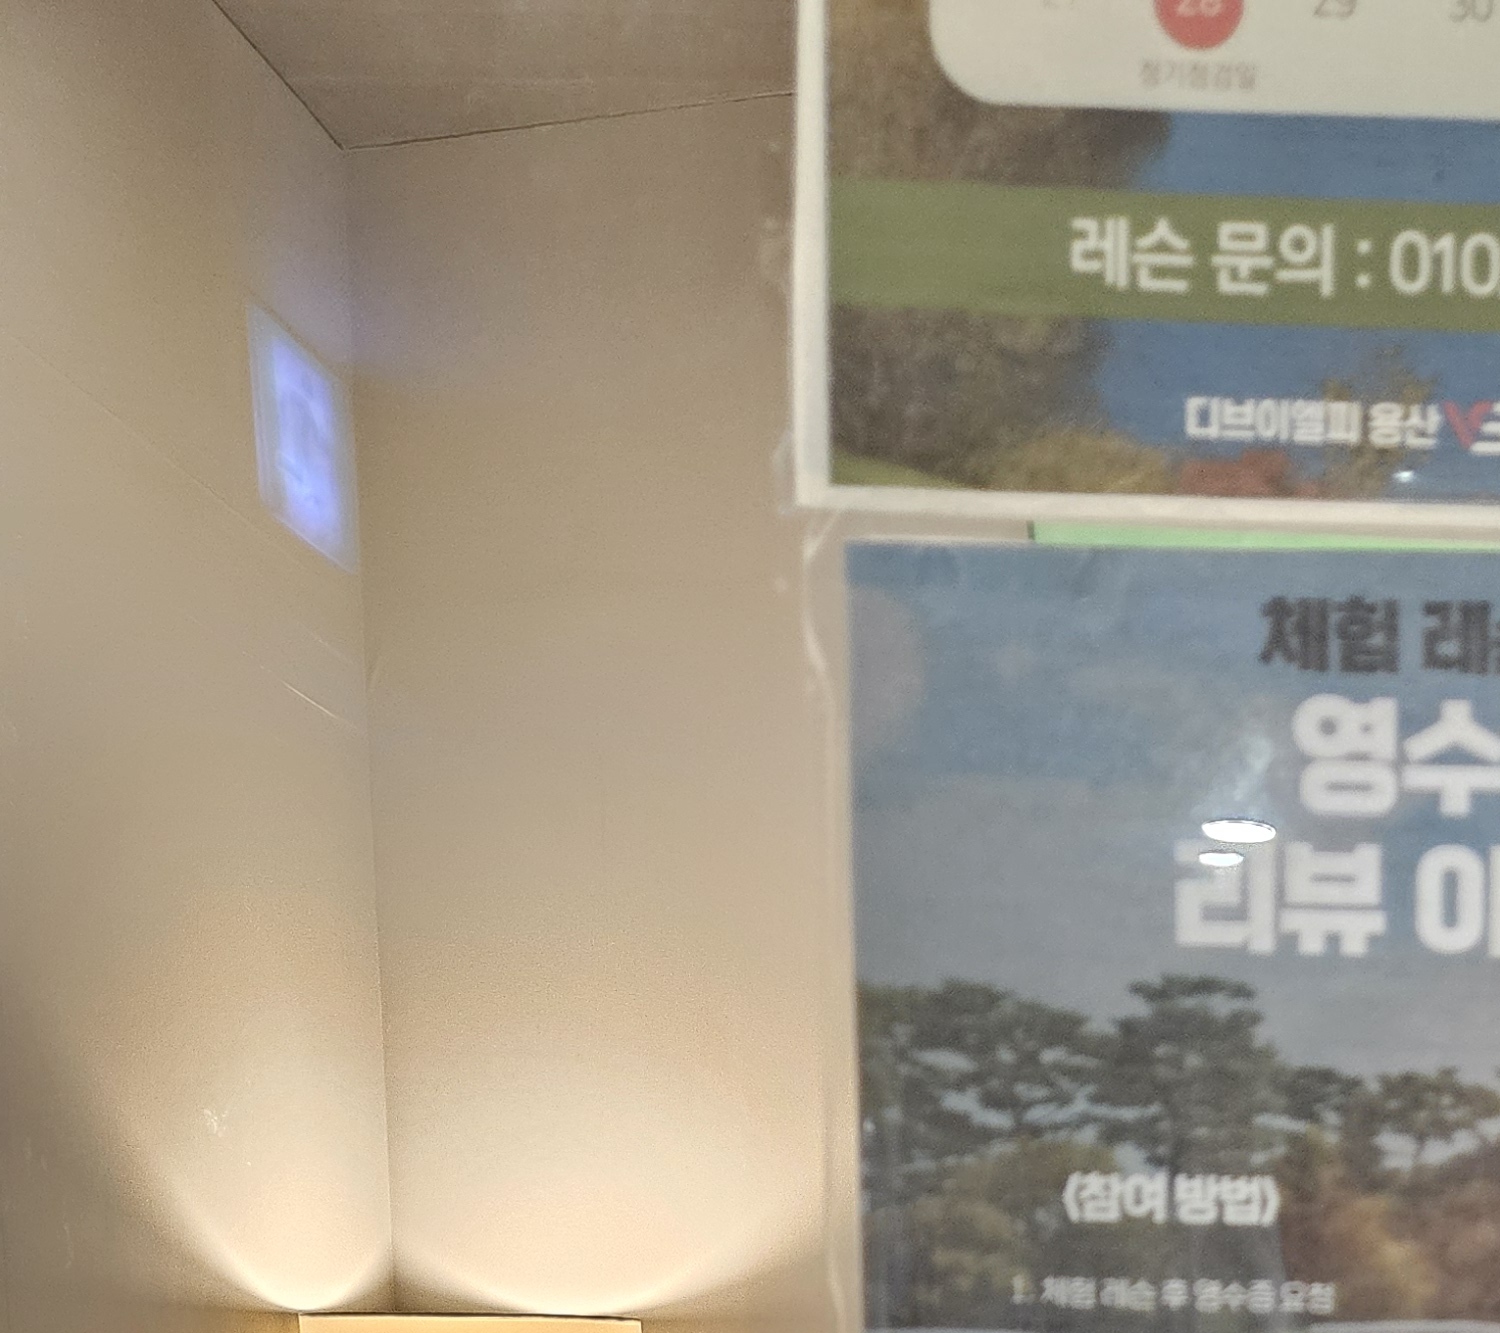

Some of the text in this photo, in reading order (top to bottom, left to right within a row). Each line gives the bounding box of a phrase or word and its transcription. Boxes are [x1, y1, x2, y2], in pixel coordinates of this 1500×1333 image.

[1070, 217, 1192, 293] 레슨
[1210, 222, 1335, 298] 문의
[1184, 396, 1362, 444] 디브이엘피
[1258, 595, 1400, 674] 체험
[1173, 839, 1388, 958] 리뷰
